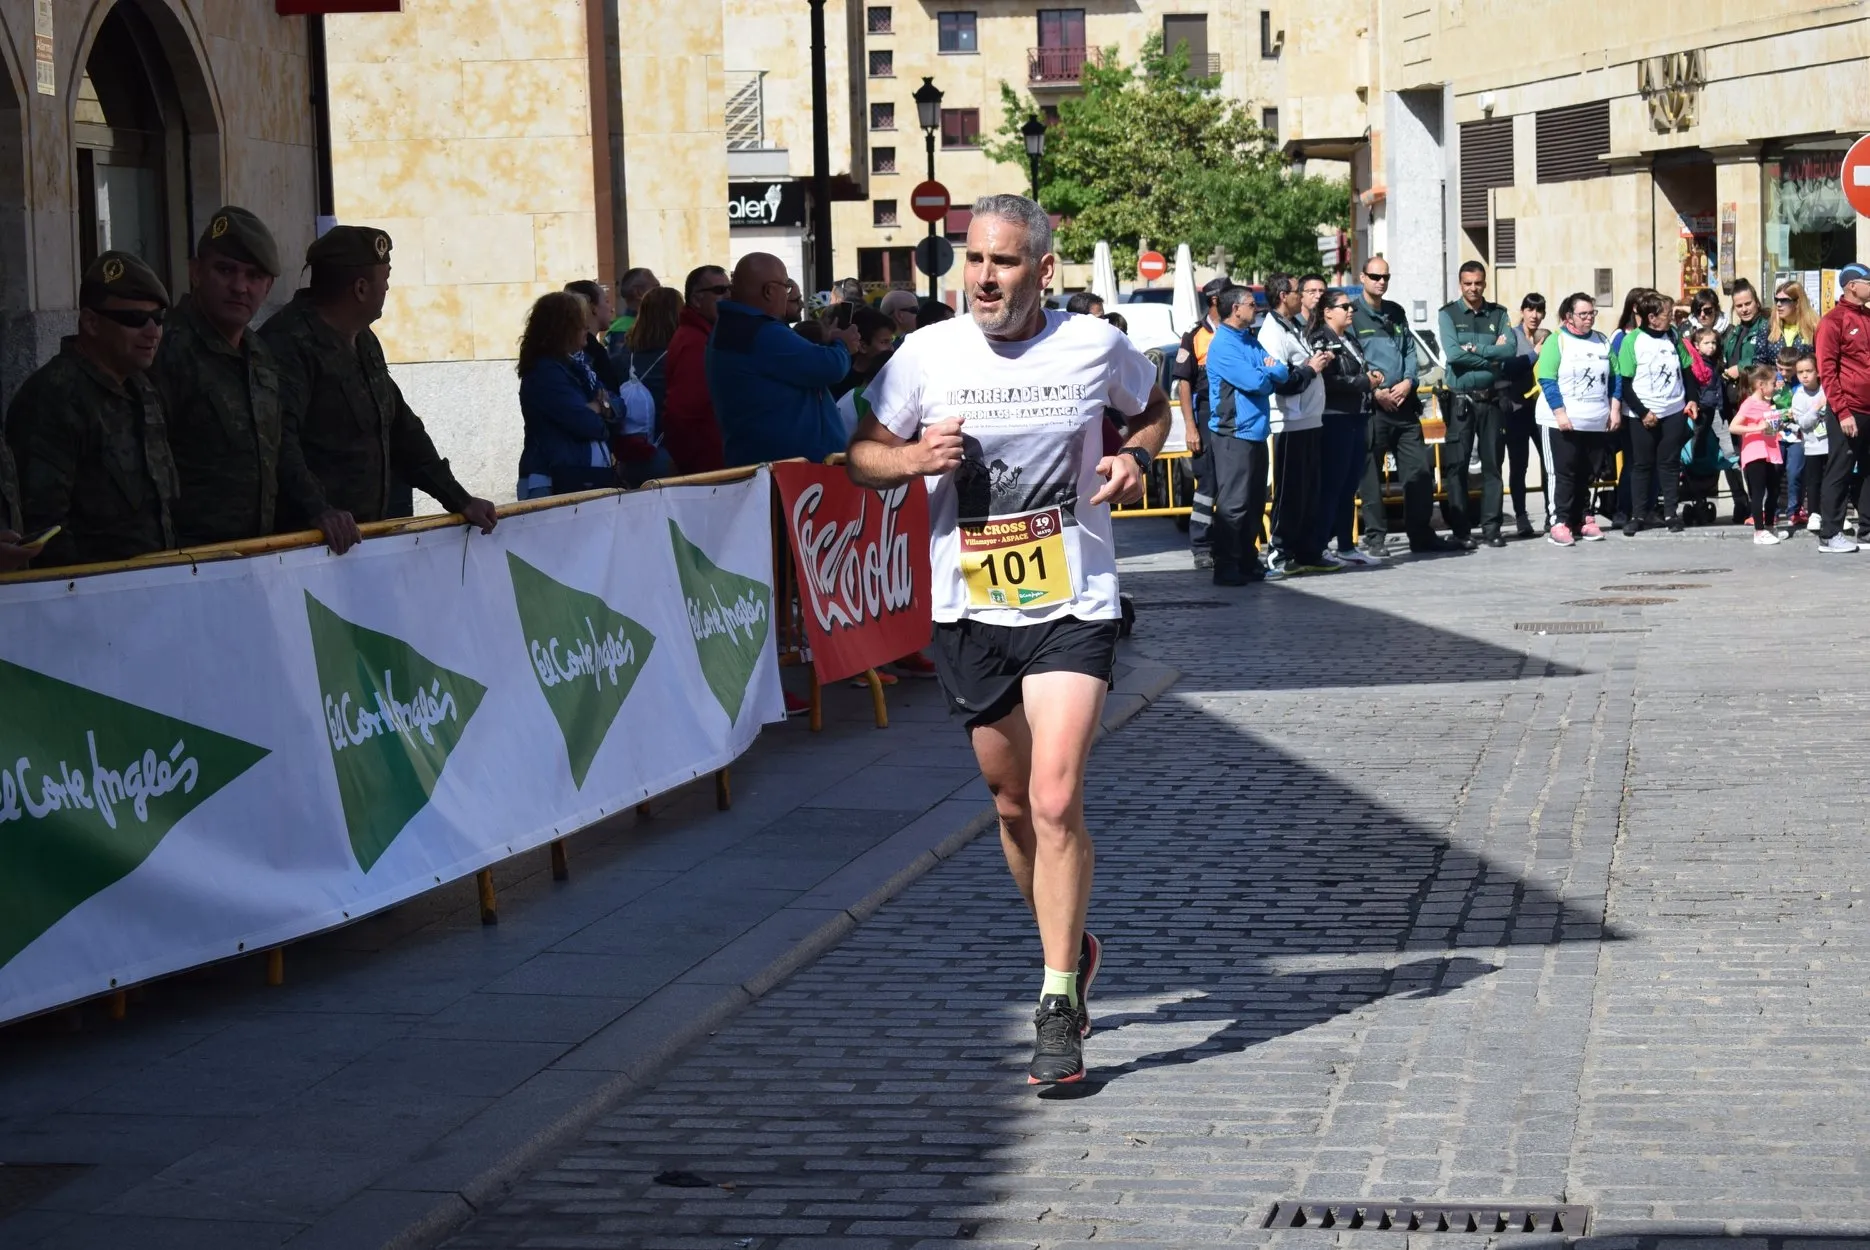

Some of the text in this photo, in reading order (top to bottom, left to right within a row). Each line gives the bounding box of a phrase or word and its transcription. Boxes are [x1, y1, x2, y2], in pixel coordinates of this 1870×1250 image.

[957, 387, 1021, 405] CARRERA
[1021, 386, 1039, 402] DE
[1040, 385, 1060, 402] LA
[1059, 383, 1087, 401] MIES
[959, 408, 1010, 420] TORDILLOS
[1016, 406, 1079, 418] SALAMANCA
[964, 521, 1027, 537] VII CROSS
[1035, 516, 1050, 527] 19
[1036, 528, 1052, 536] MAYO
[965, 538, 997, 546] Villamayor
[1001, 532, 1029, 543] ASPACE
[980, 545, 1047, 586] 101
[687, 597, 703, 641] El
[710, 583, 766, 646] Inglés
[531, 616, 635, 692] El Corte Inglés
[325, 693, 348, 751] El
[384, 669, 458, 750] Inglés
[15, 756, 95, 819] Corte
[87, 729, 199, 830] Inglés
